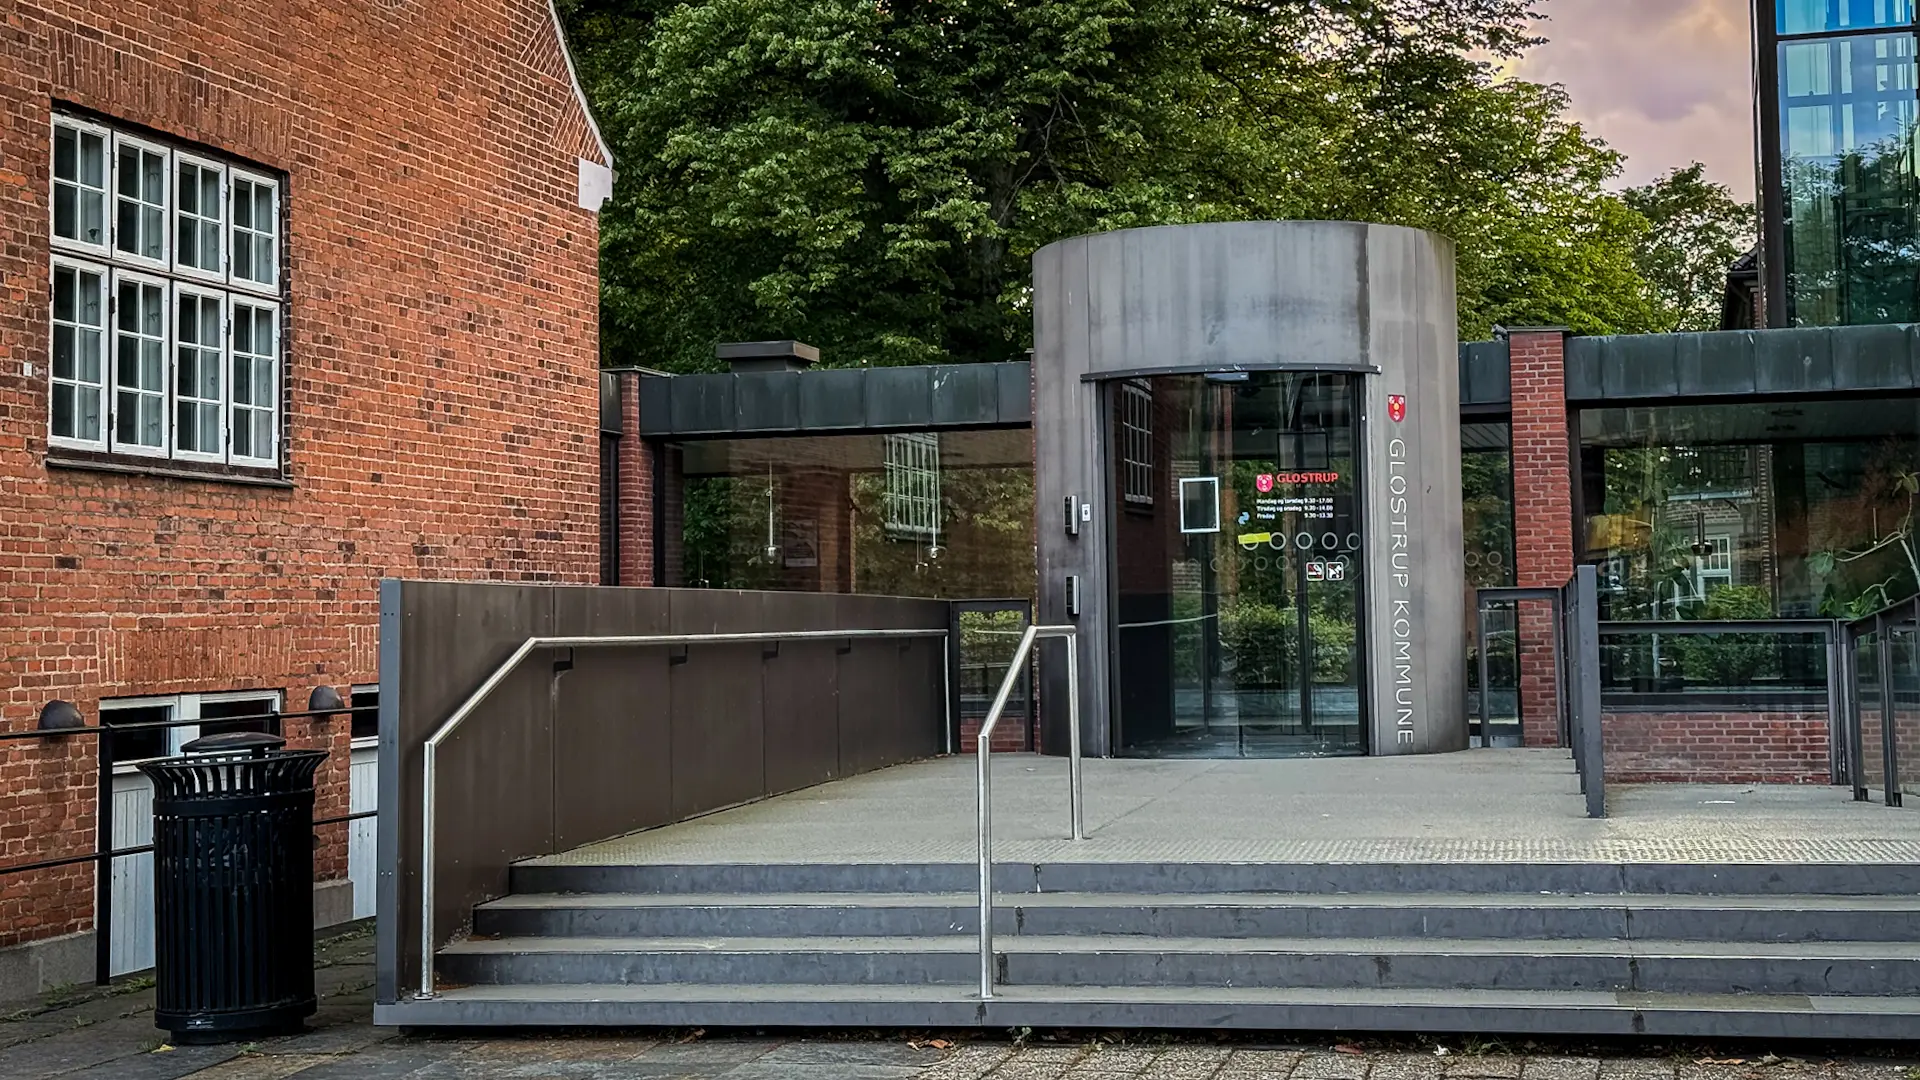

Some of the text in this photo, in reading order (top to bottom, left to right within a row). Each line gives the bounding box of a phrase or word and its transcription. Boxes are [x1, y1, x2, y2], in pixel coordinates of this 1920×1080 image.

[1276, 472, 1339, 483] GLOSTRUP
[1389, 438, 1413, 744] GLOSTRUP KOMMUNE
